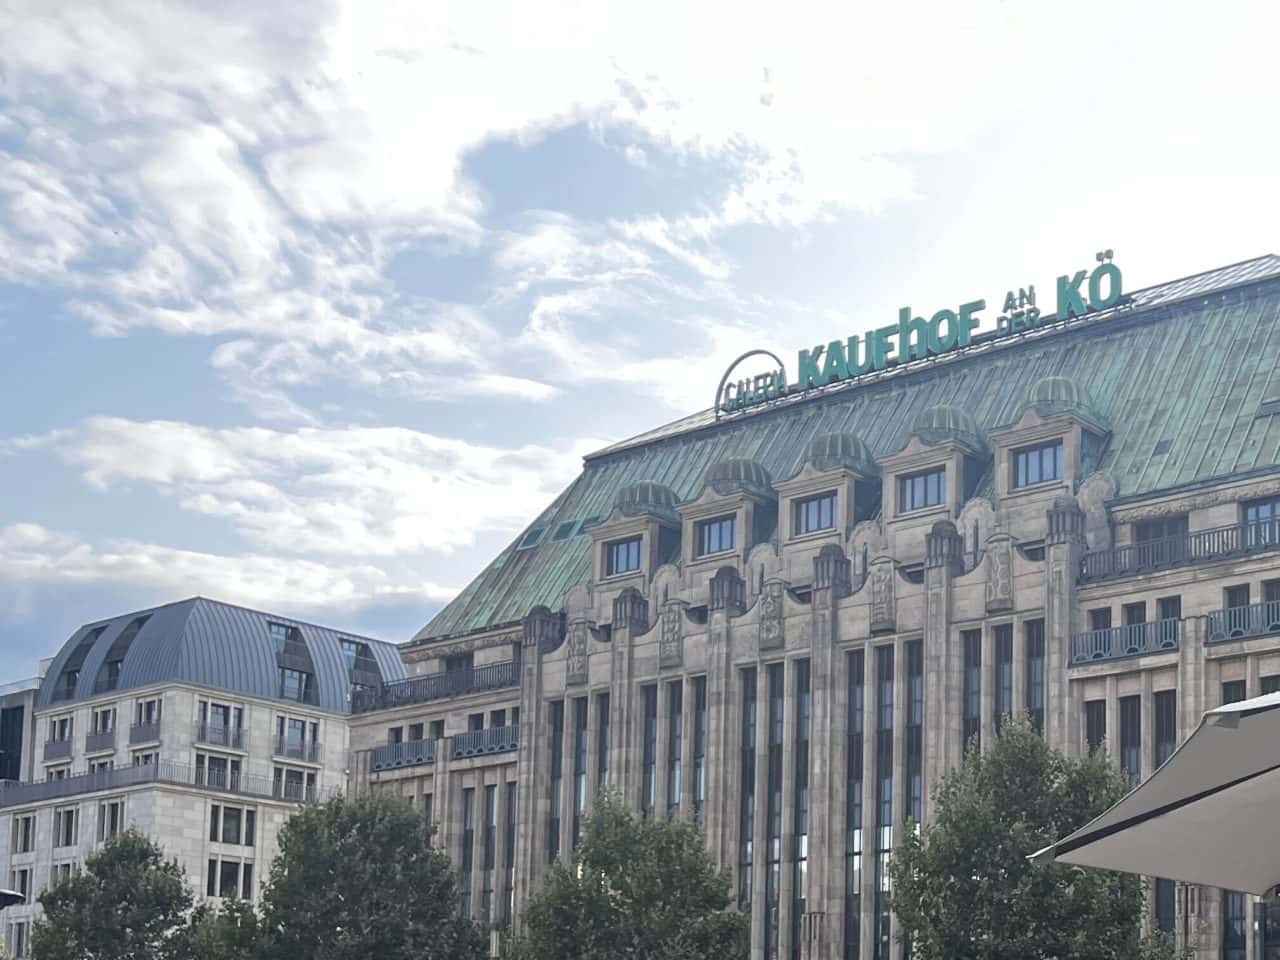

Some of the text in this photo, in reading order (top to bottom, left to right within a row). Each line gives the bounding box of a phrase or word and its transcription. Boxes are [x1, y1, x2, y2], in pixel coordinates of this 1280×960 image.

[1056, 249, 1123, 320] KÖ
[1002, 285, 1036, 313] AN
[997, 307, 1041, 335] DER
